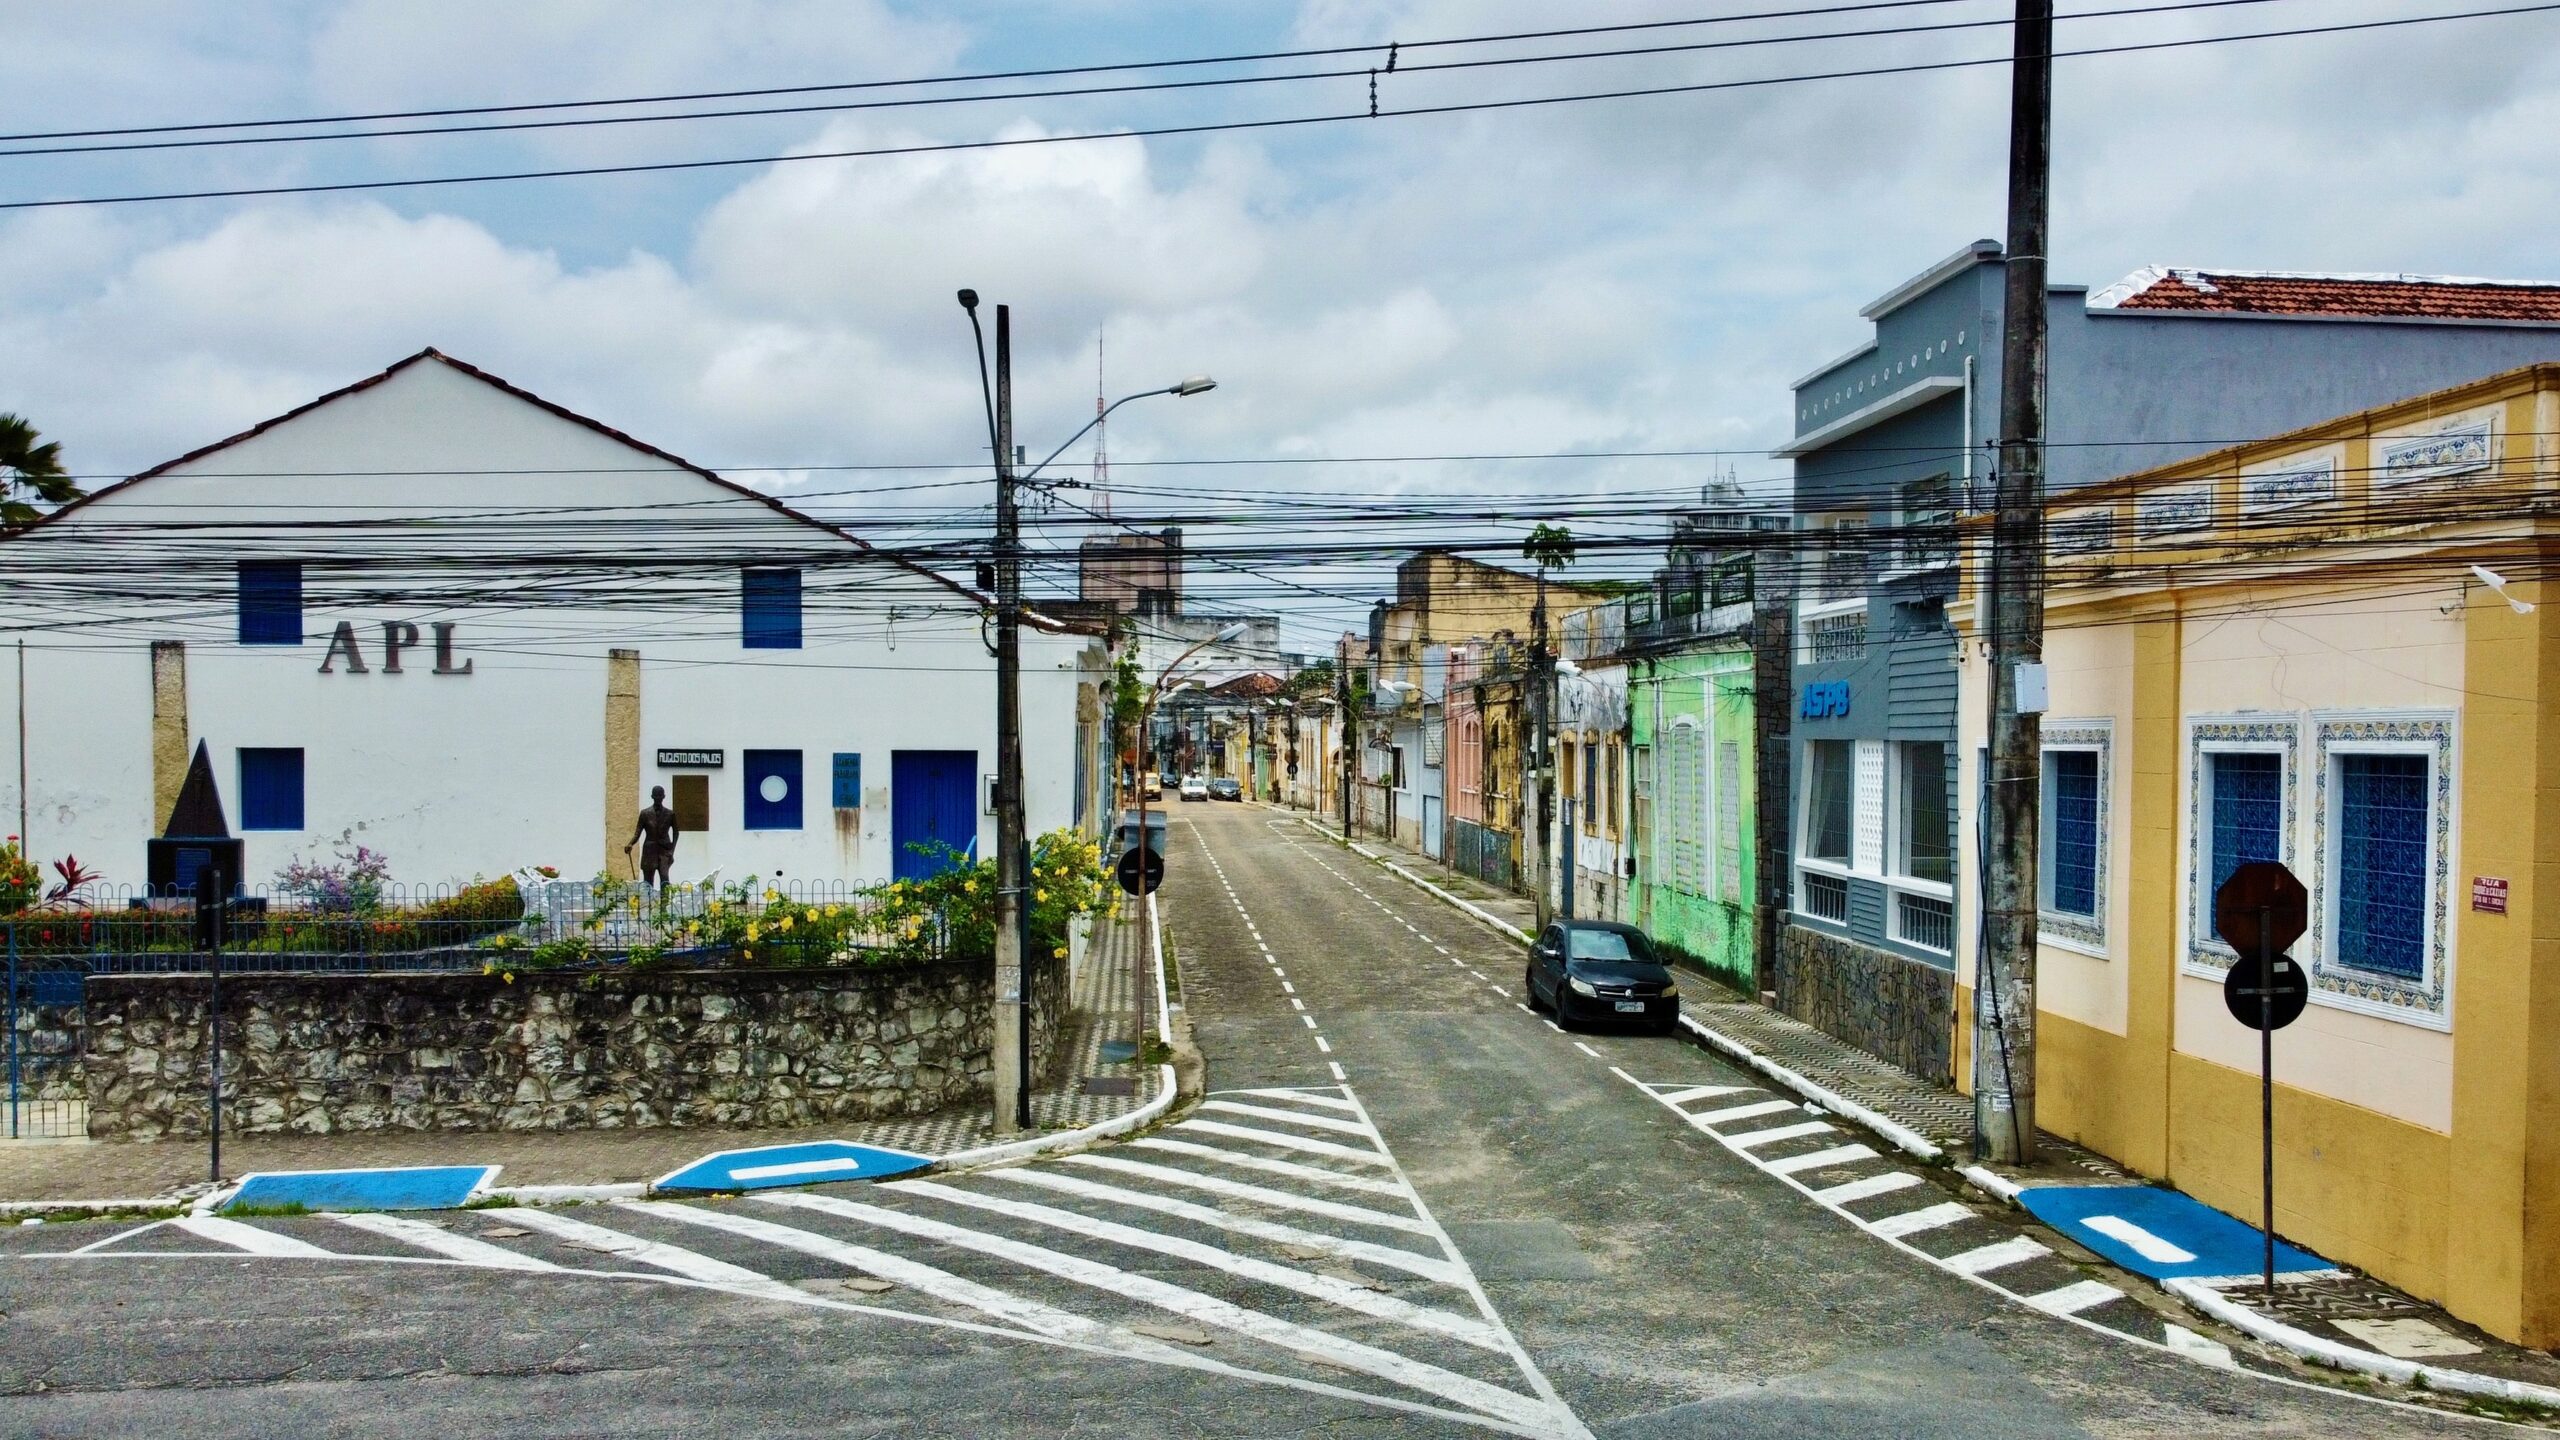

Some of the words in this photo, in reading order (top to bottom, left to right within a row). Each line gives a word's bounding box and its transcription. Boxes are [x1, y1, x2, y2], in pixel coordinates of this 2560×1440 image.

[317, 620, 473, 675] APL
[1800, 679, 1849, 719] ASPB
[2481, 878, 2500, 887] RUA
